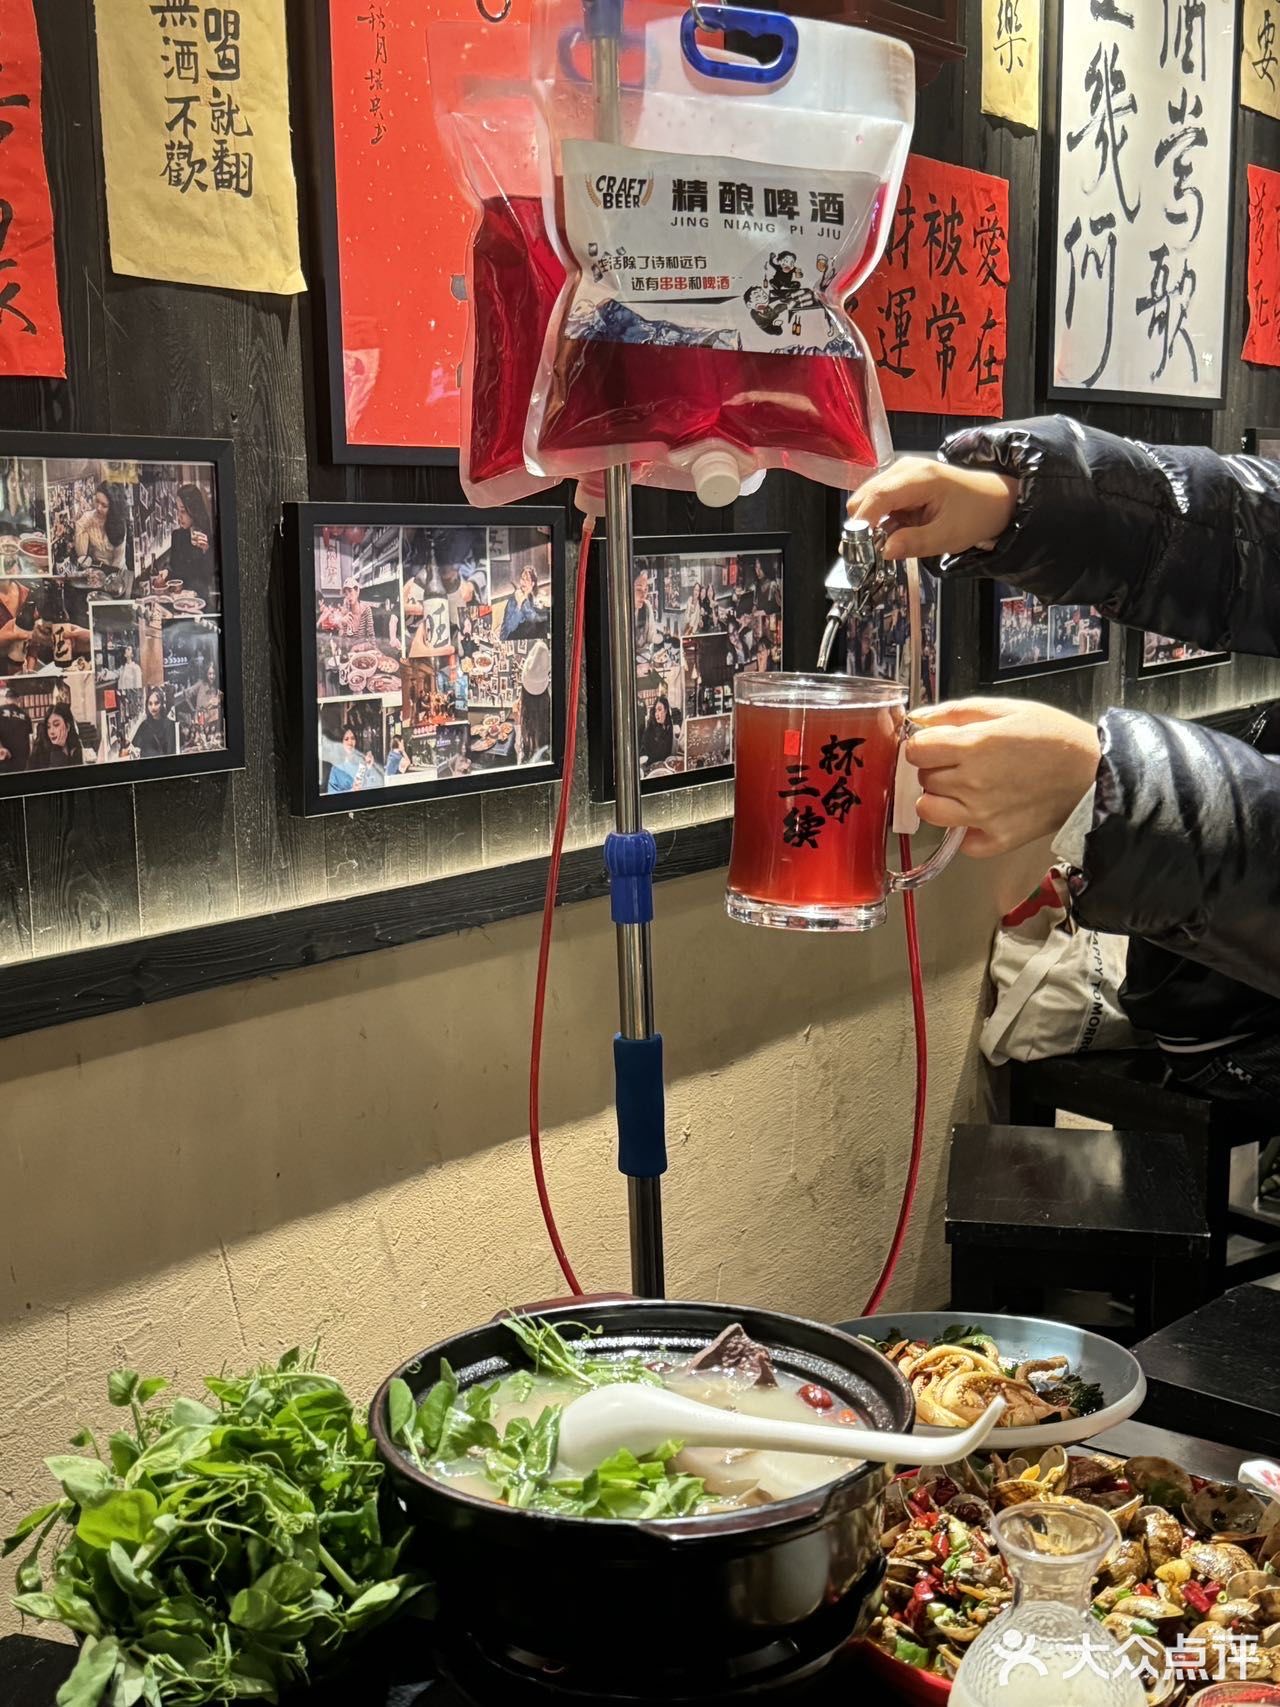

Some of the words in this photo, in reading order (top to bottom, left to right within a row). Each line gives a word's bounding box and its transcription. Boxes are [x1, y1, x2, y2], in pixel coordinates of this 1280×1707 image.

[595, 175, 647, 195] CRAFT
[602, 193, 640, 209] BEER
[672, 179, 844, 226] 精酿啤酒
[670, 216, 710, 228] JING
[724, 219, 776, 233] NIANG
[790, 225, 803, 235] PI
[817, 227, 841, 240] JIU
